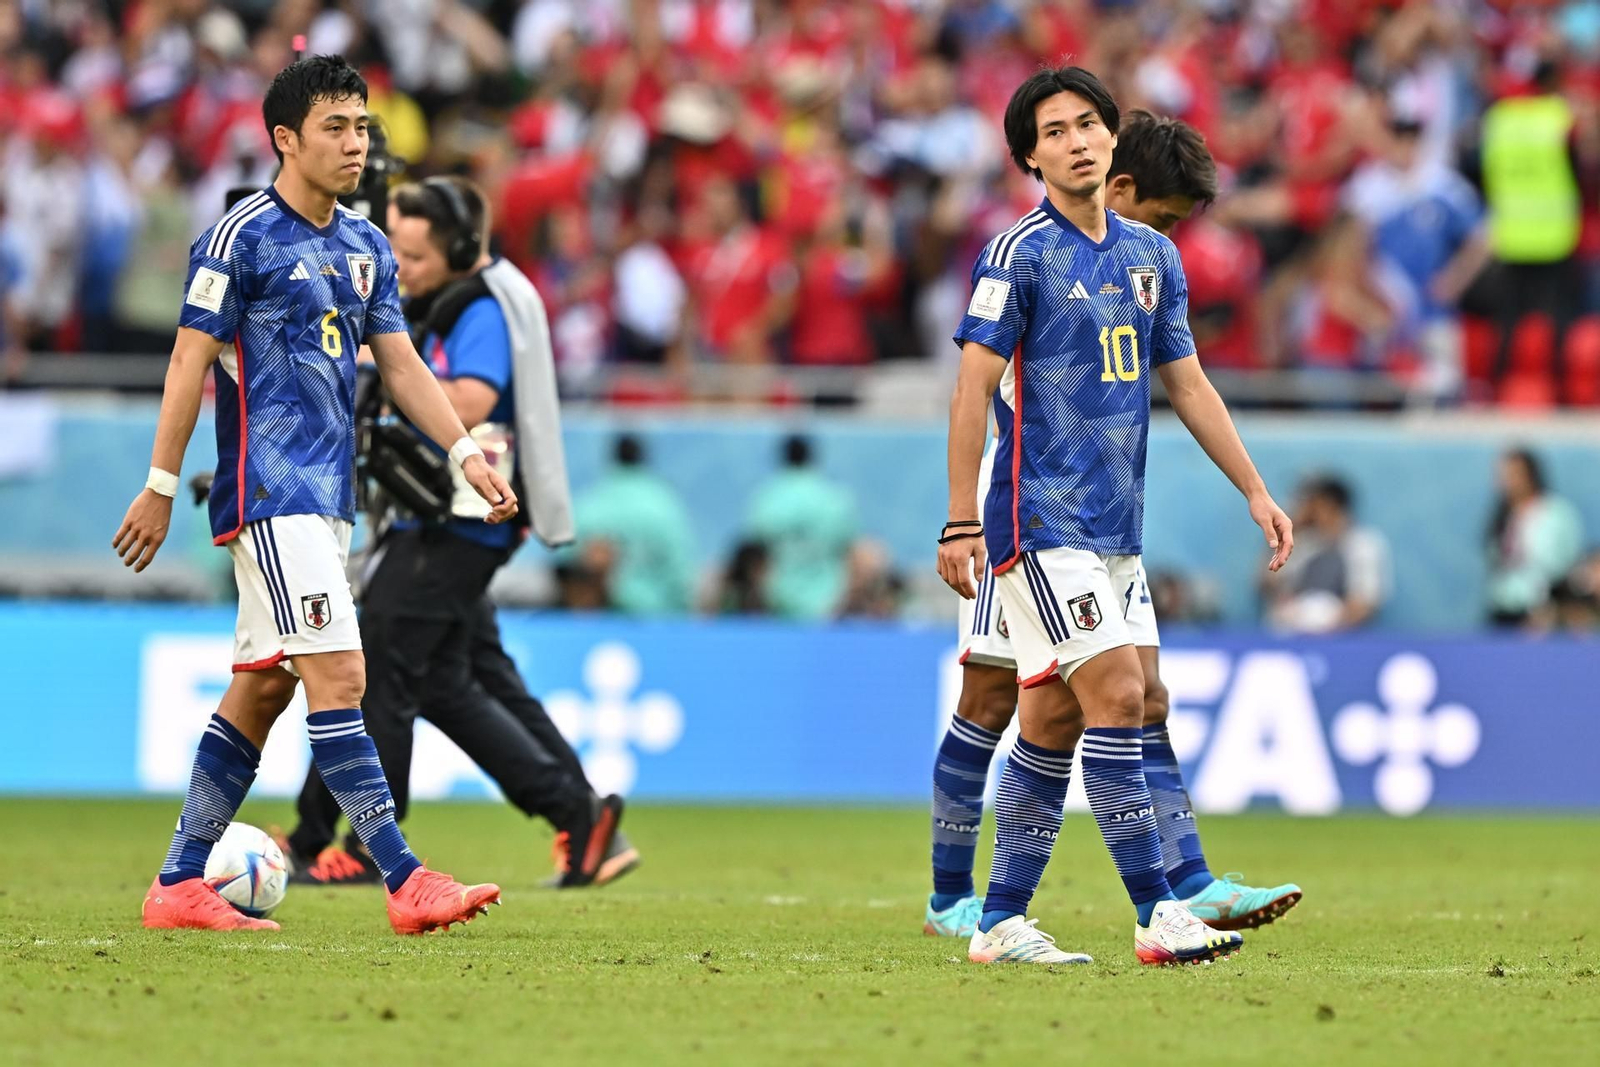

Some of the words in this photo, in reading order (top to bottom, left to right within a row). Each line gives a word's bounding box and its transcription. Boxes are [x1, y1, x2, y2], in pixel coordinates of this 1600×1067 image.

[321, 307, 342, 358] 6
[1099, 326, 1140, 382] 10
[359, 798, 395, 824] JAPA
[1111, 805, 1154, 822] JAPA
[937, 820, 980, 833] JAPA
